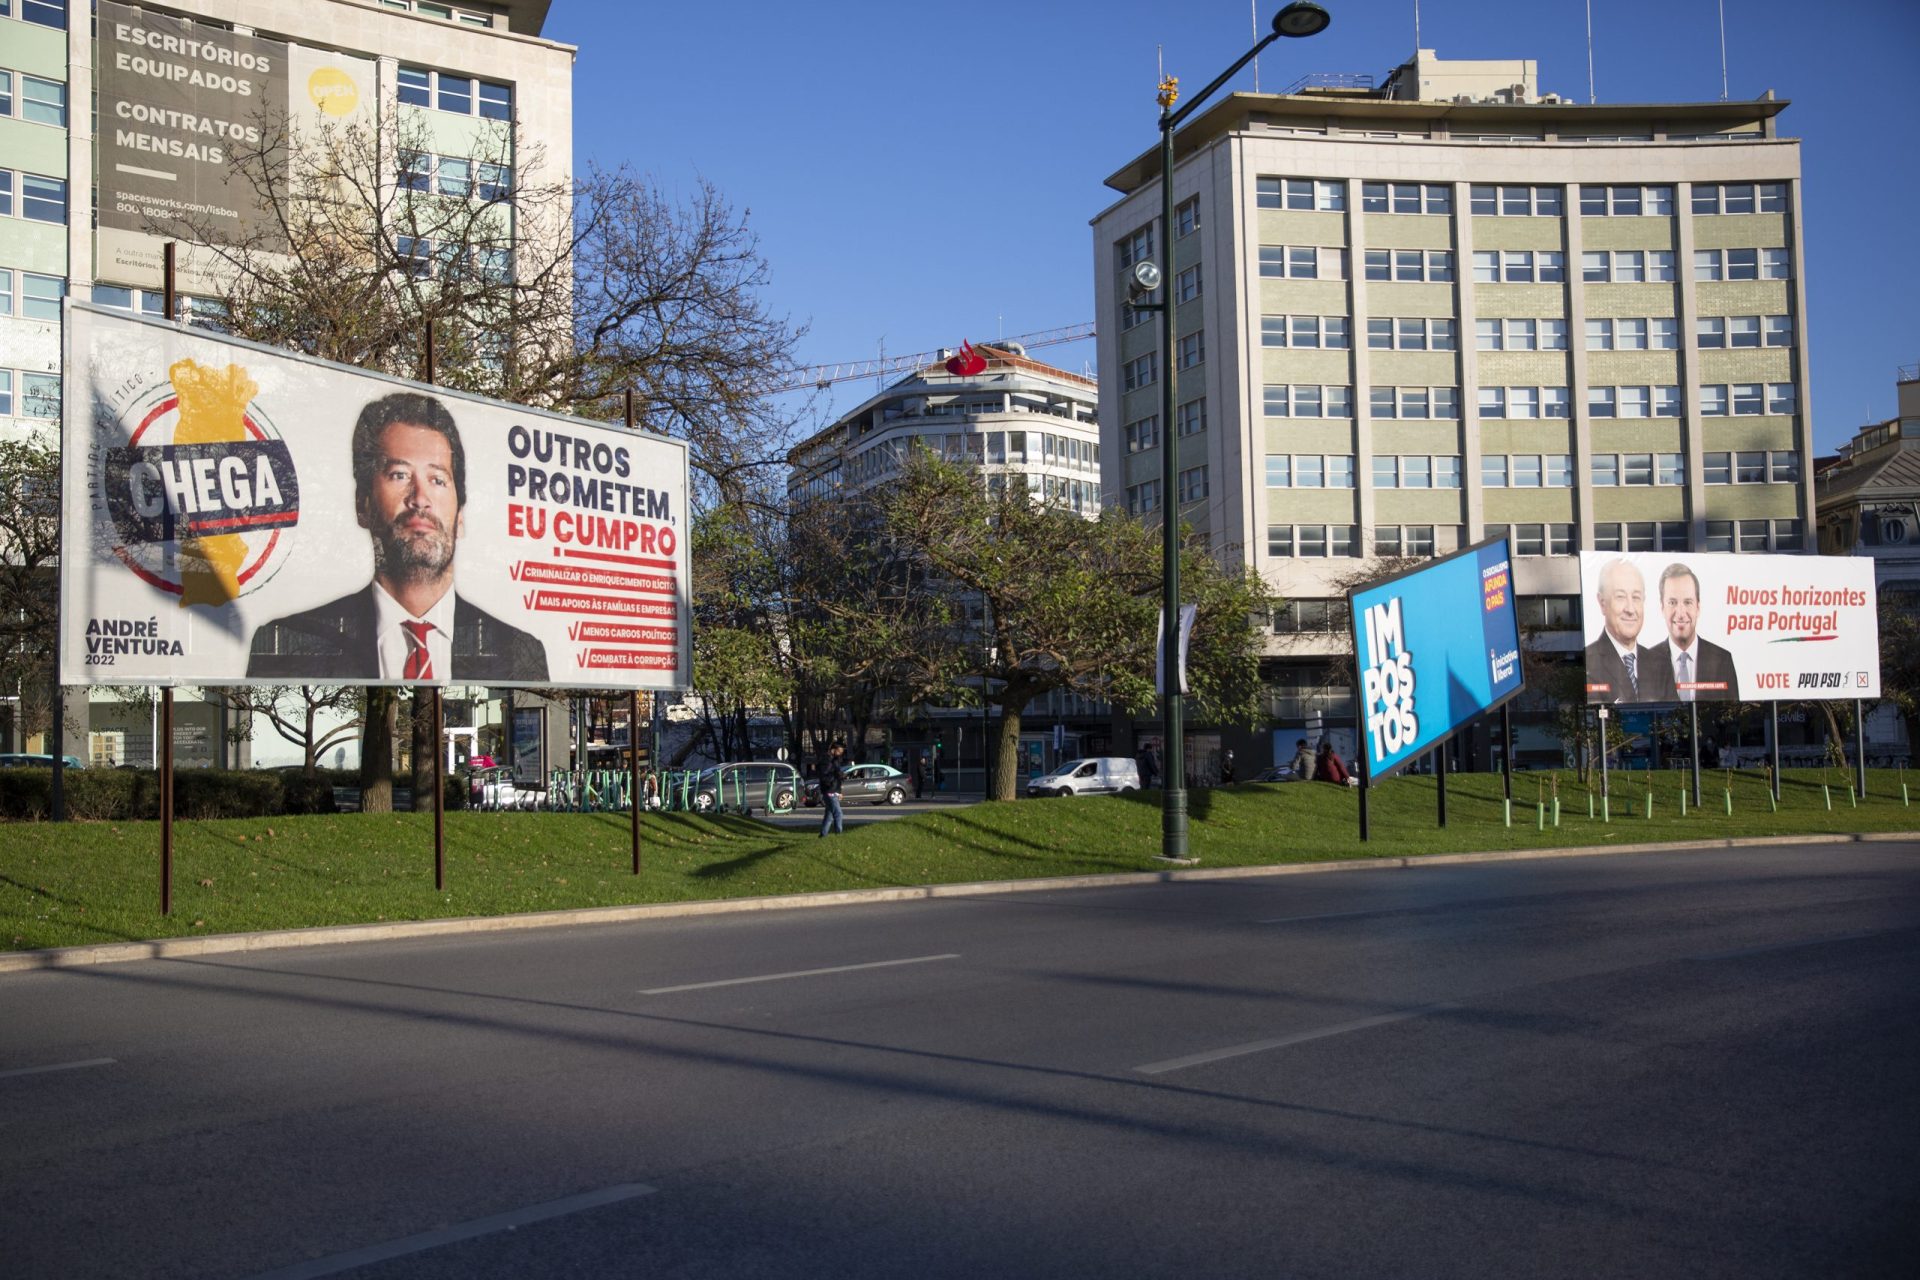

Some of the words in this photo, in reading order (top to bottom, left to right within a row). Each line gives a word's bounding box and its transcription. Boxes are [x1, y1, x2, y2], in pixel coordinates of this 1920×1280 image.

[116, 23, 270, 73] ESCRITÓRIOS
[116, 52, 252, 96] EQUIPADOS
[116, 101, 260, 143] CONTRATOS
[116, 129, 223, 164] MENSAIS
[116, 191, 239, 218] spacesworks.com/lisboa
[116, 202, 139, 214] 800
[508, 425, 630, 478] OUTROS
[129, 455, 283, 518] CHEGA
[508, 463, 676, 526] PROMETEM,
[508, 504, 546, 540] EU
[553, 511, 676, 556] CUMPRO
[525, 567, 581, 582] CRIMINALIZAR
[582, 574, 588, 582] O
[589, 574, 651, 588] ENRIQUECIMENTO
[652, 577, 676, 591] ILÍCITO
[540, 596, 560, 607] MAIS
[561, 598, 590, 609] APOIOS
[591, 598, 602, 610] ÀS
[602, 600, 635, 613] FAMÍLIAS
[636, 604, 641, 613] E
[641, 604, 677, 616] EMPRESAS
[1726, 585, 1778, 605] Novos
[1781, 585, 1866, 606] horizontes
[86, 616, 158, 637] ANDRÉ
[583, 626, 609, 637] MENOS
[611, 628, 641, 639] CARGOS
[642, 628, 677, 641] POLÍTICOS
[1364, 597, 1404, 668] IM
[1727, 614, 1764, 635] para
[1768, 610, 1838, 635] Portugal
[85, 637, 184, 656] VENTURA
[85, 655, 115, 665] 2022
[591, 653, 626, 664] COMBATE
[627, 653, 633, 664] À
[634, 654, 676, 667] CORRUPÇÃO
[1364, 652, 1415, 716] POS
[1756, 673, 1790, 689] VOTE
[1797, 673, 1819, 688] PPD
[1820, 672, 1842, 688] PSD
[1368, 698, 1418, 762] TOS
